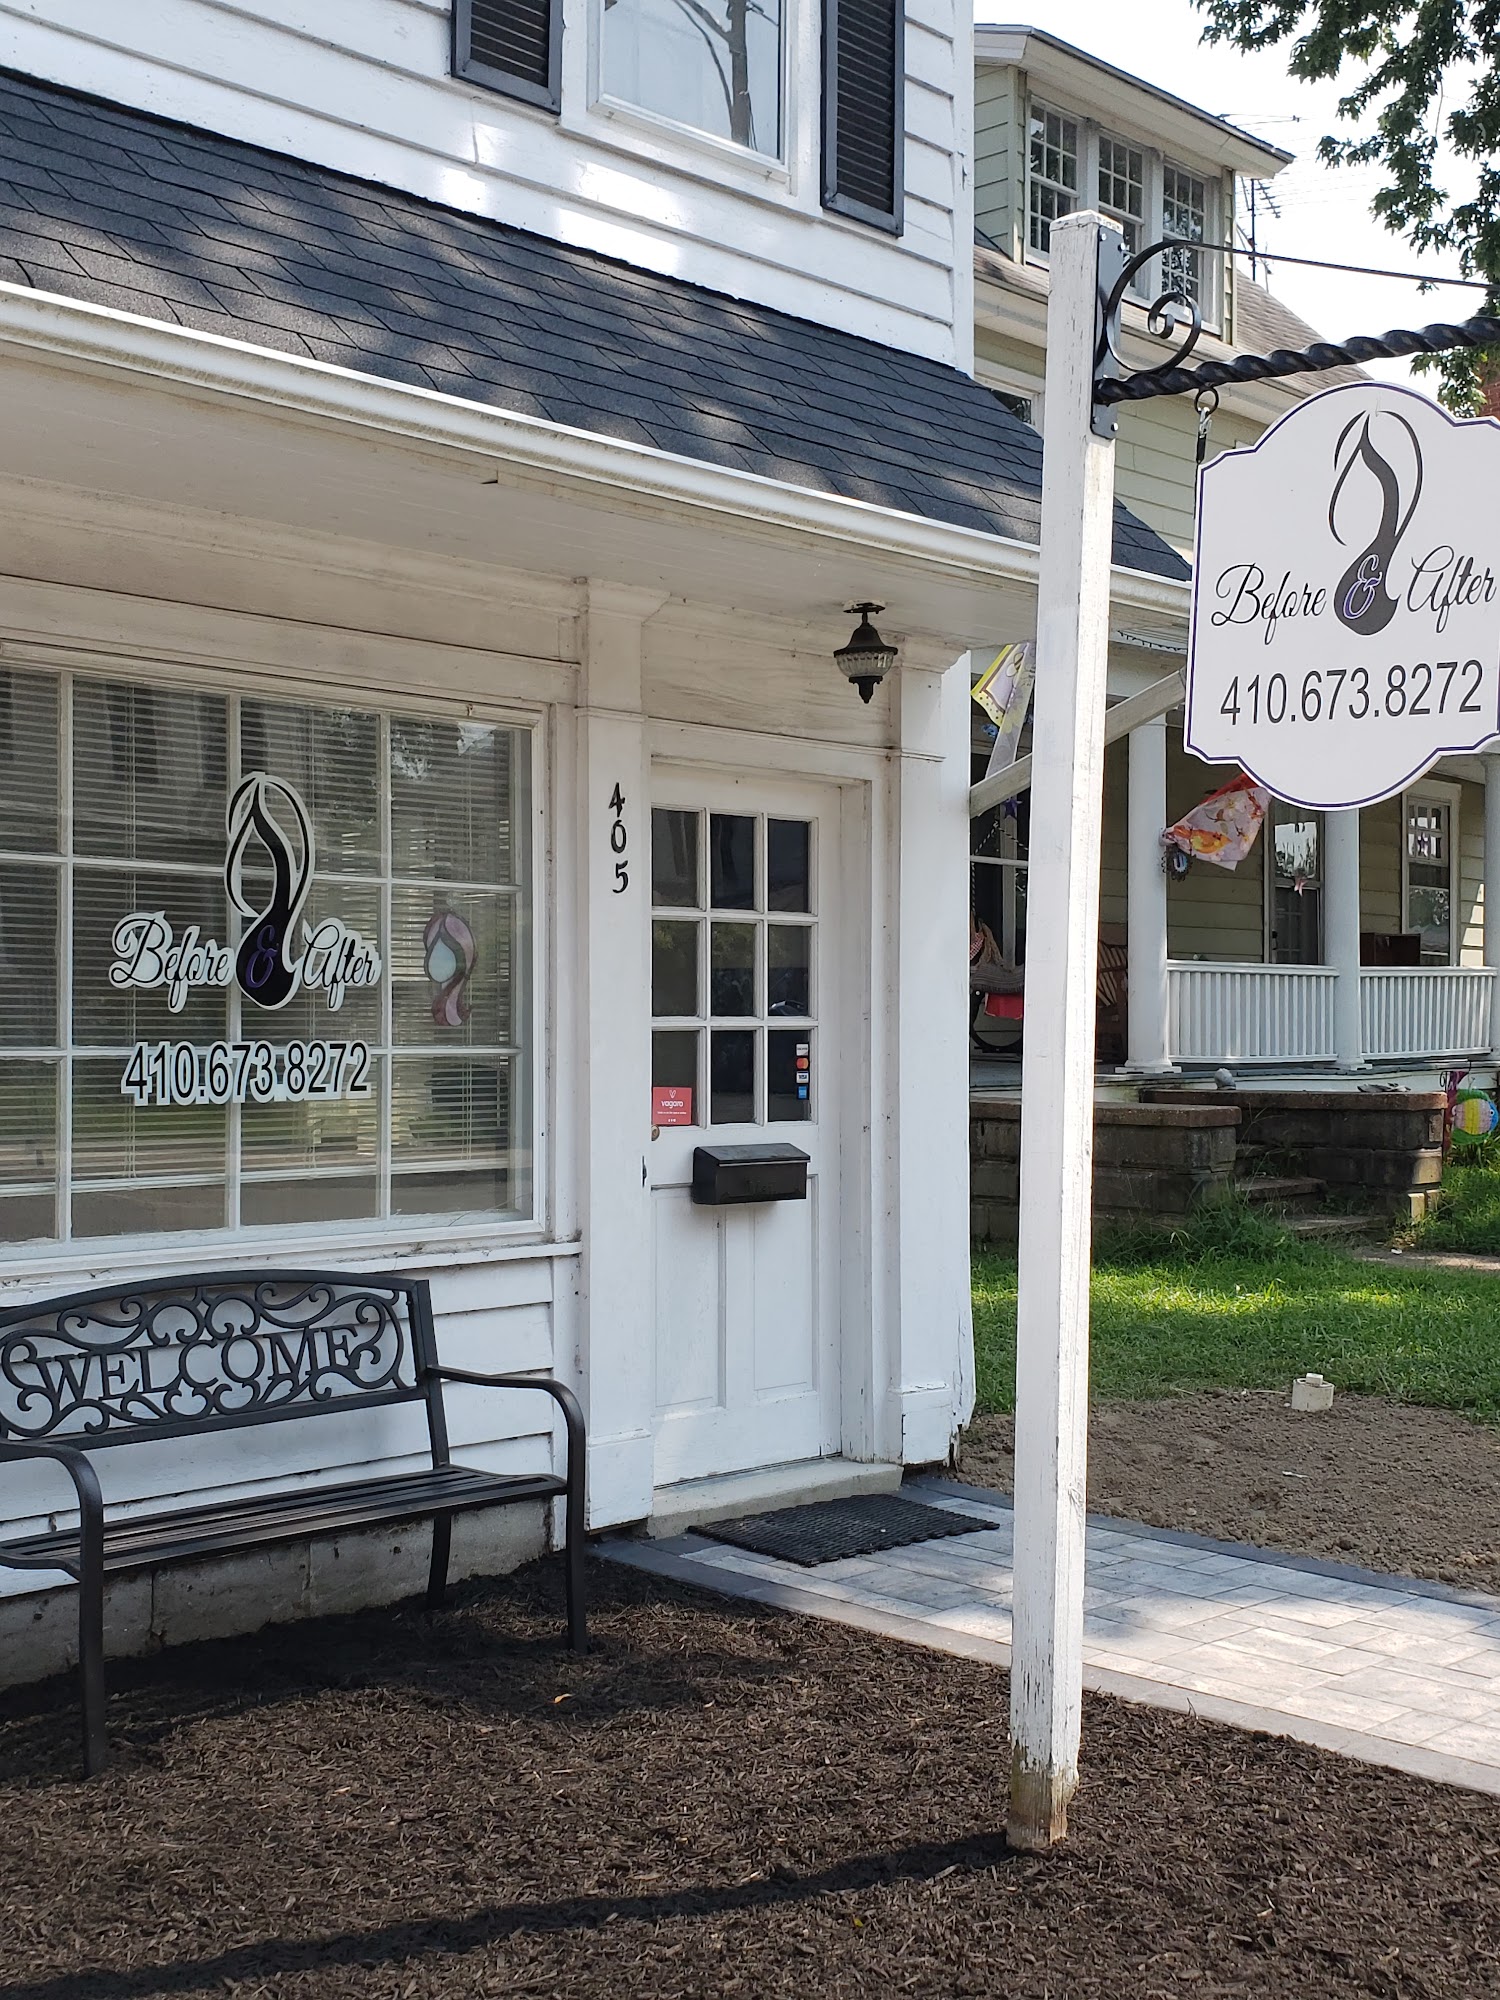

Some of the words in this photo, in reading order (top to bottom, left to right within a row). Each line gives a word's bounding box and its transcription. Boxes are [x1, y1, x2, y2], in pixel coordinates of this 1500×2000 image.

[1211, 562, 1326, 646] Before
[1343, 554, 1382, 620] &
[1407, 545, 1497, 633] After
[1220, 659, 1484, 726] 410.673.8272
[608, 782, 629, 894] 405
[110, 917, 230, 1010] Before
[245, 924, 278, 988] &
[302, 924, 377, 1010] After
[124, 1041, 369, 1100] 410.673.8272
[28, 1325, 360, 1410] WELCOME
